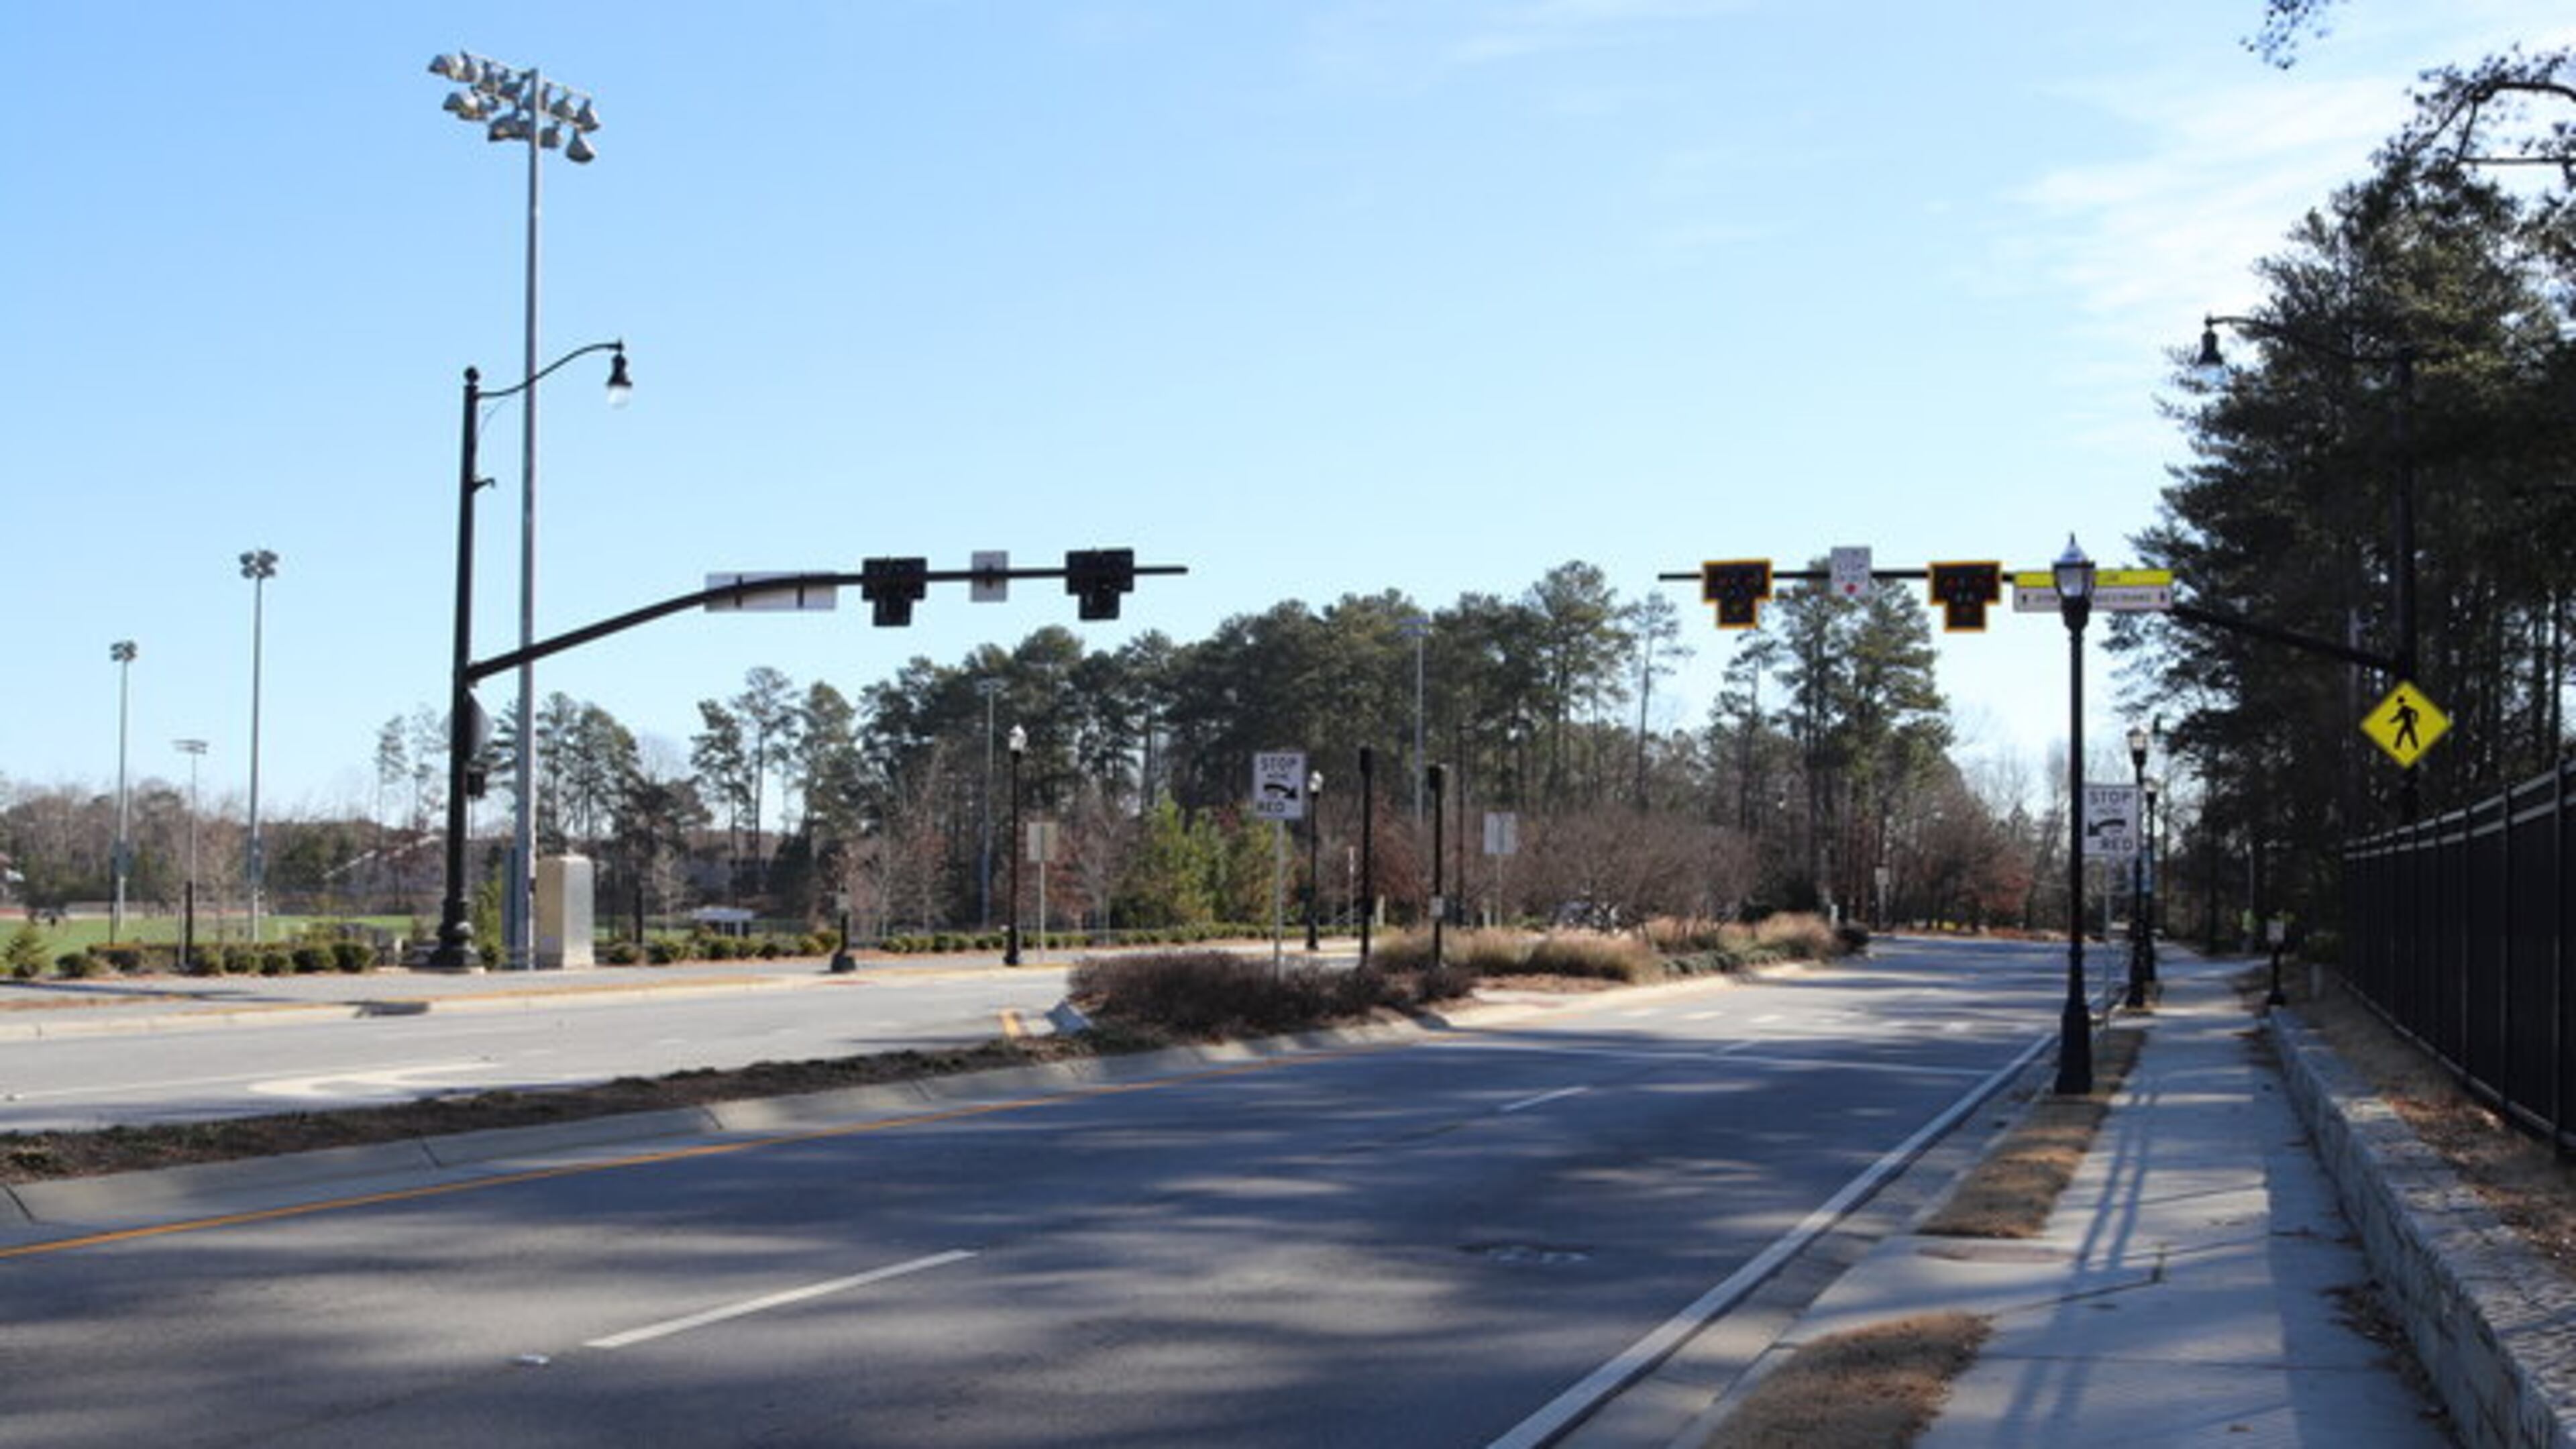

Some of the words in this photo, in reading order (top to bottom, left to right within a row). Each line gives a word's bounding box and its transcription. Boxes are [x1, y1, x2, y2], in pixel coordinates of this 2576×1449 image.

[1260, 757, 1298, 771] STOP
[2088, 791, 2133, 805] STOP
[2099, 837, 2134, 851] RED
